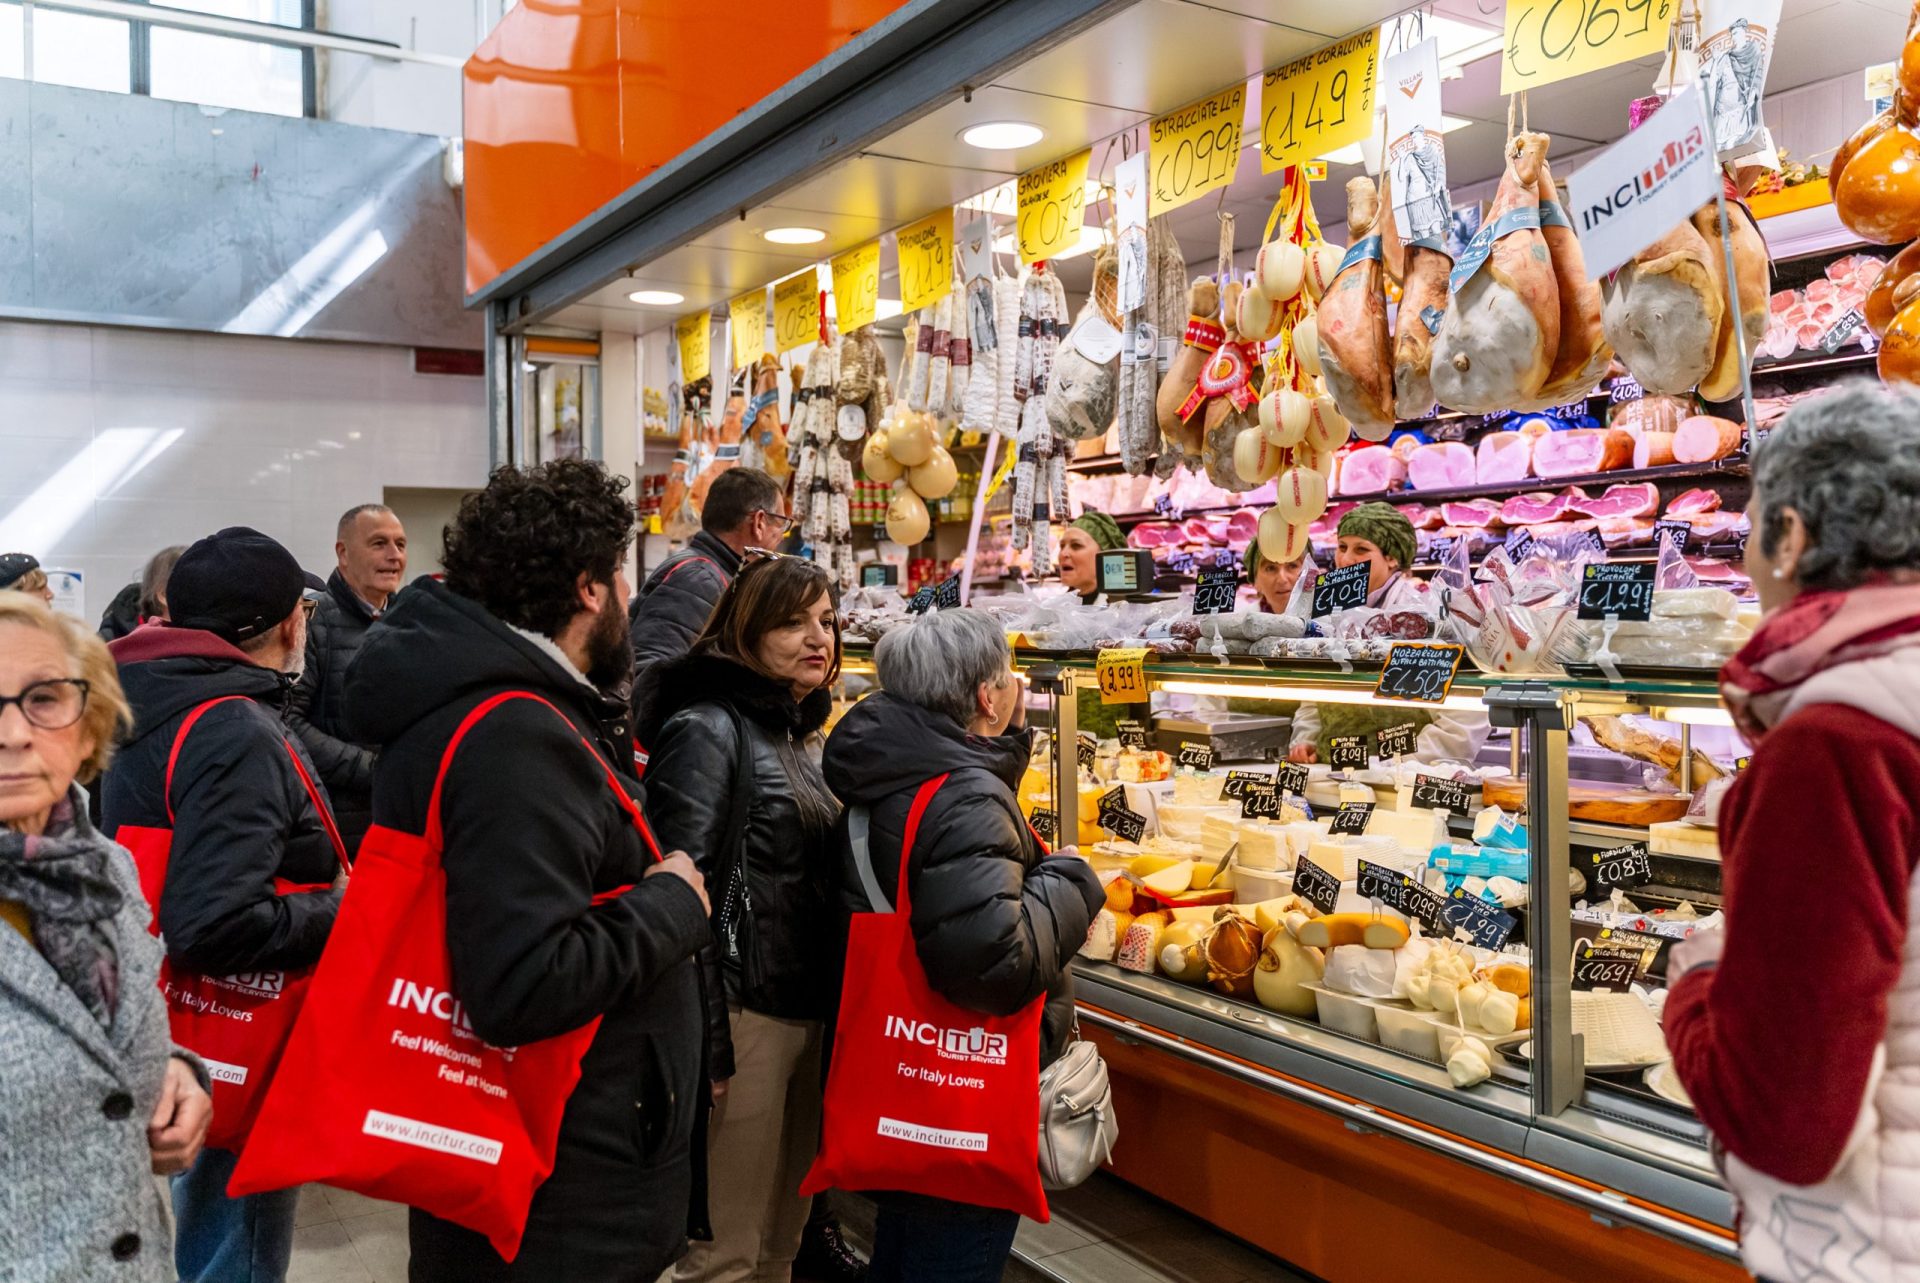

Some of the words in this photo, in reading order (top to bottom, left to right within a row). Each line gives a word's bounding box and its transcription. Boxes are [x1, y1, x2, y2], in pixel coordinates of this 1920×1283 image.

[1265, 62, 1312, 87] SALAME
[1317, 31, 1373, 66] CORALLINA
[1398, 71, 1423, 87] VILLANI
[1153, 90, 1241, 143] STRACCIATELLA
[1018, 160, 1067, 195] GROVIERA
[1325, 563, 1366, 580] CORALLINA
[1594, 565, 1642, 574] PROVOLONE
[1392, 647, 1443, 659] MOZZARELLA
[236, 985, 281, 1000] SERVICES
[181, 990, 209, 1013] Italy
[210, 1000, 254, 1022] Lovers
[391, 1029, 422, 1051] Feel
[884, 1014, 1007, 1060] INCITUR
[936, 1048, 969, 1062] TOURIST
[438, 1063, 465, 1085] Feel
[465, 1074, 479, 1088] at
[897, 1062, 918, 1078] For
[919, 1066, 946, 1087] Italy
[948, 1073, 985, 1089] Lovers
[371, 1115, 499, 1160] www.incitur.com
[881, 1122, 986, 1149] www.incitur.com
